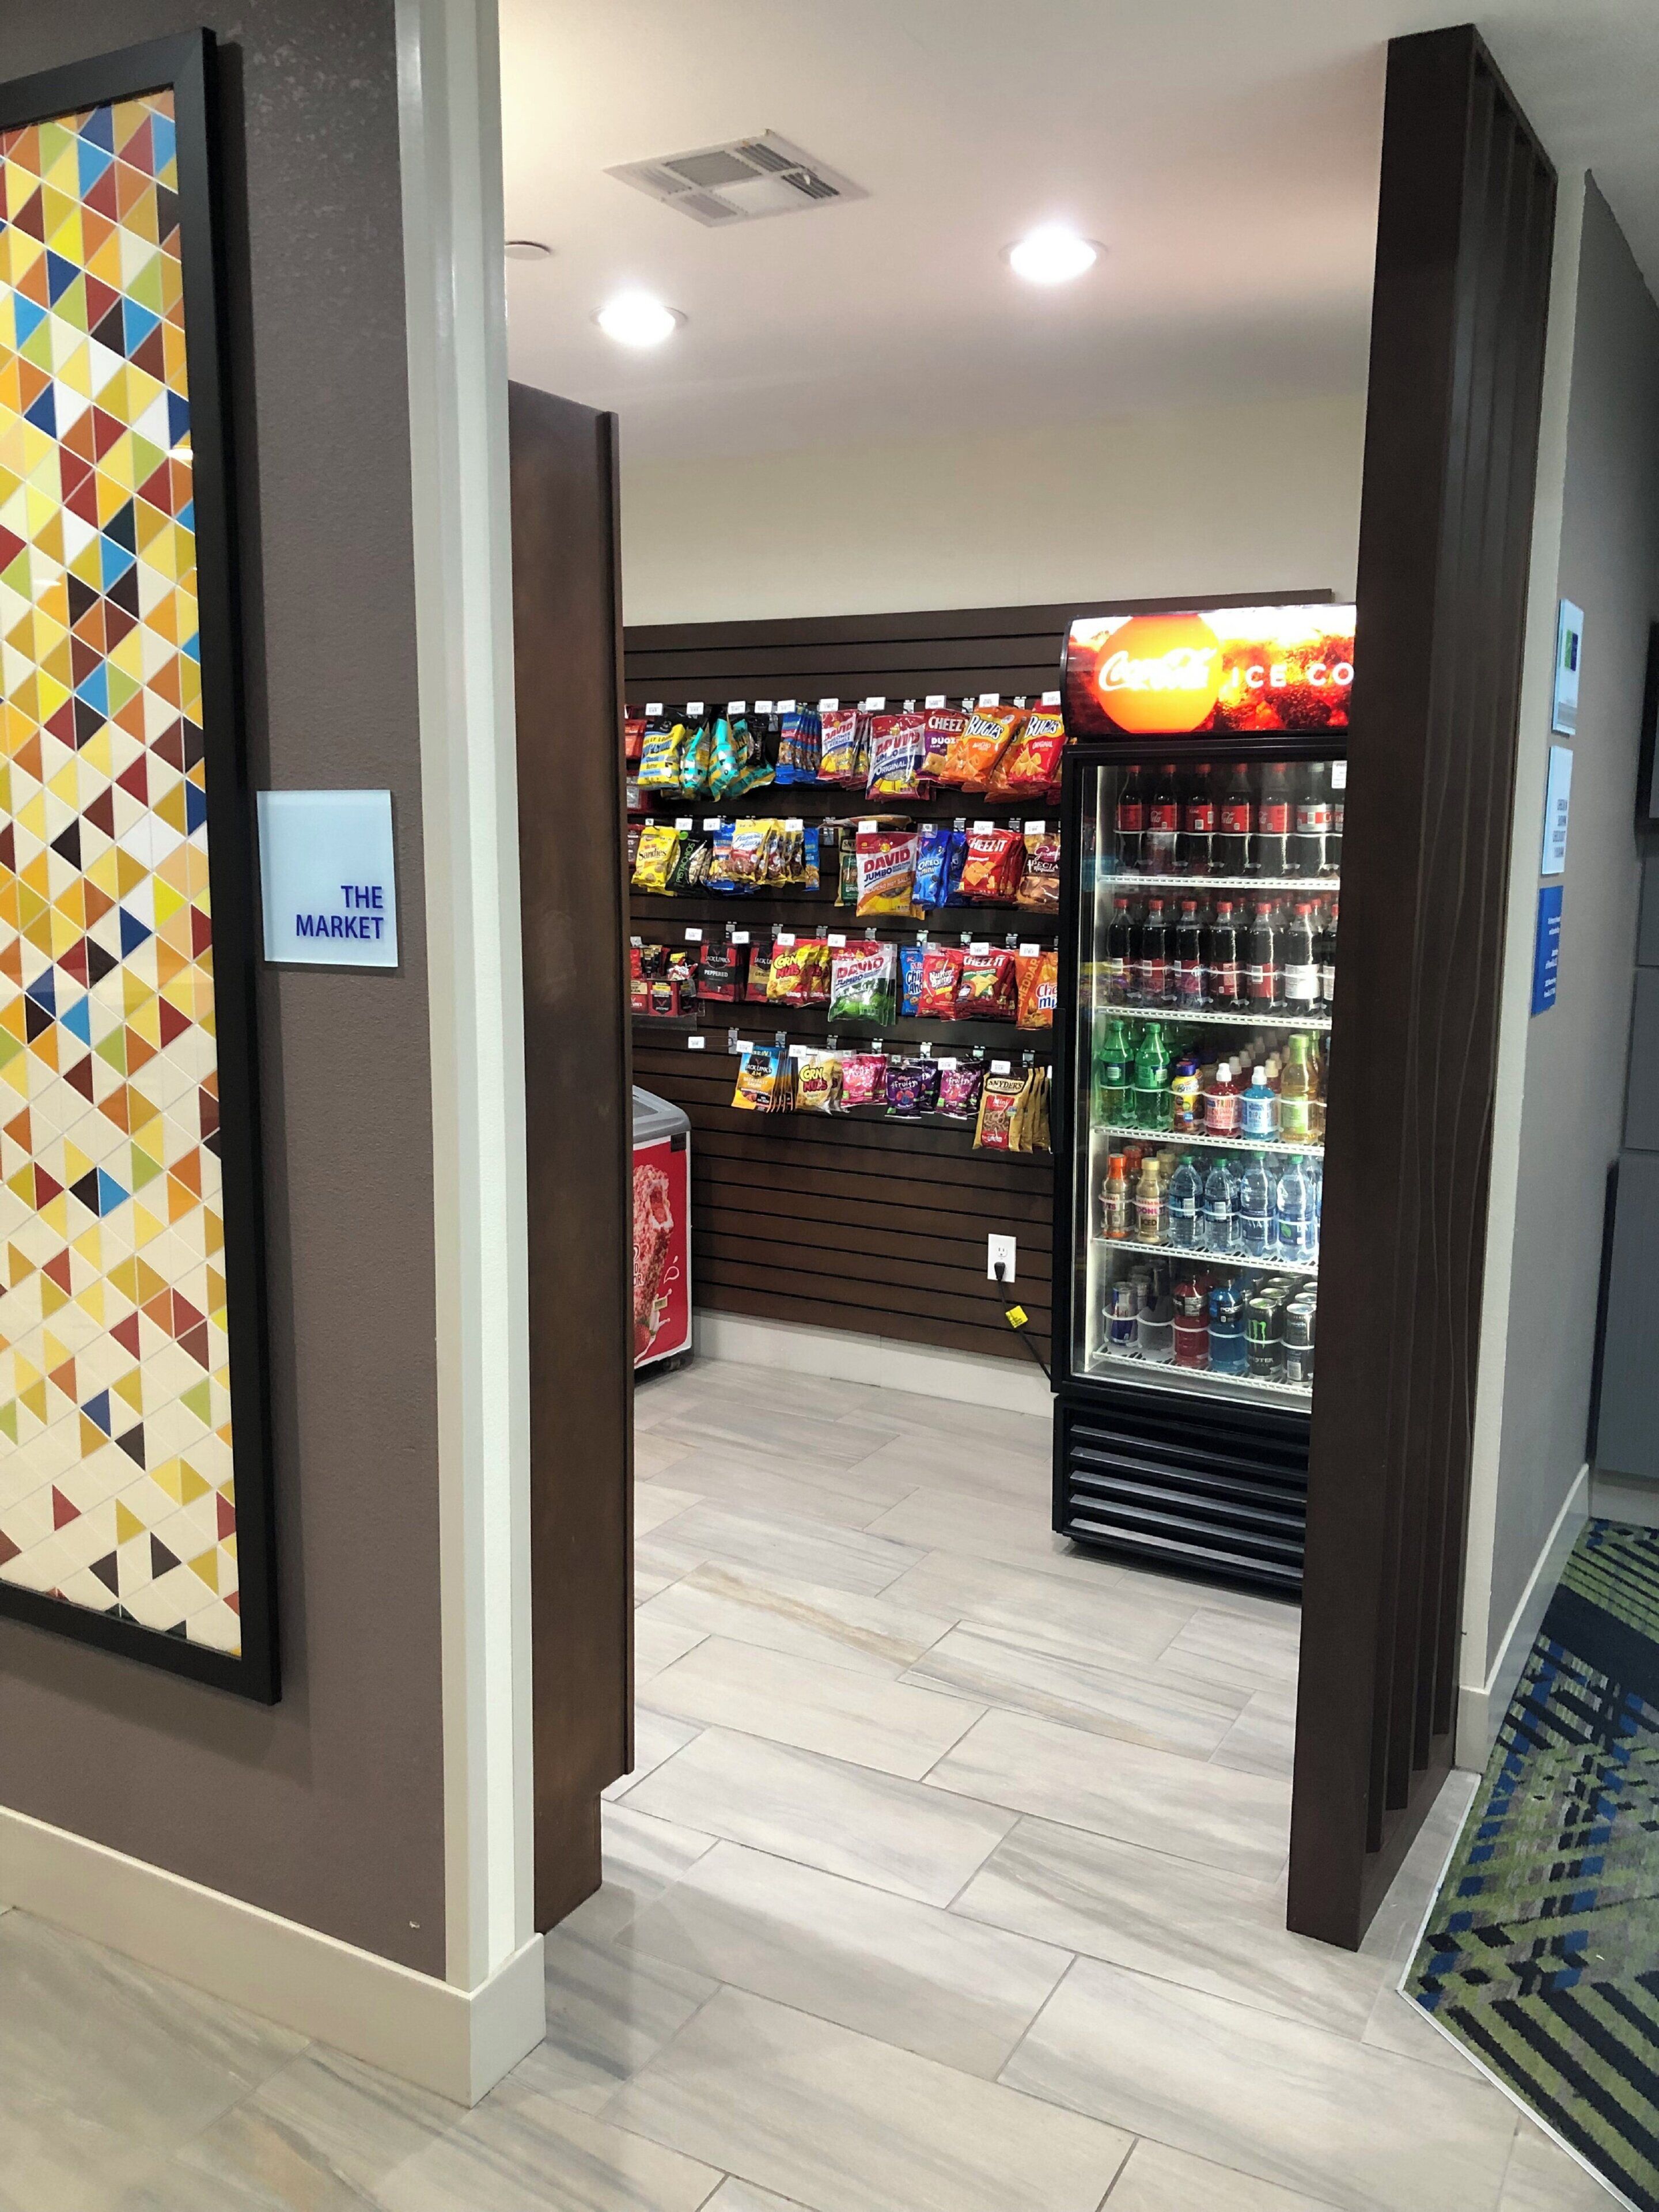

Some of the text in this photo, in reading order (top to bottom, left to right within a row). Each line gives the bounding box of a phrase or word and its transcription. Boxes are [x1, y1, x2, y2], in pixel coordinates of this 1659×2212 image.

[1232, 665, 1286, 688] ICE
[825, 723, 853, 739] DAVID
[964, 715, 1004, 740] BUGLES
[876, 732, 921, 756] DAVID
[876, 760, 907, 775] ORIGINAL
[639, 848, 666, 861] Sandies
[864, 848, 910, 873] DAVID
[676, 843, 695, 883] PISTACHIOS
[918, 859, 940, 870] OREO
[864, 866, 892, 881] JUMBO
[341, 885, 383, 908] THE
[296, 914, 384, 939] MARKET
[774, 953, 798, 969] CORN
[837, 957, 884, 979] DAVID
[704, 969, 728, 978] PEPPERED
[776, 964, 801, 979] NUTS
[800, 1064, 824, 1082] CORN
[803, 1079, 828, 1092] NUTS
[988, 1080, 1022, 1089] SNYDER'S
